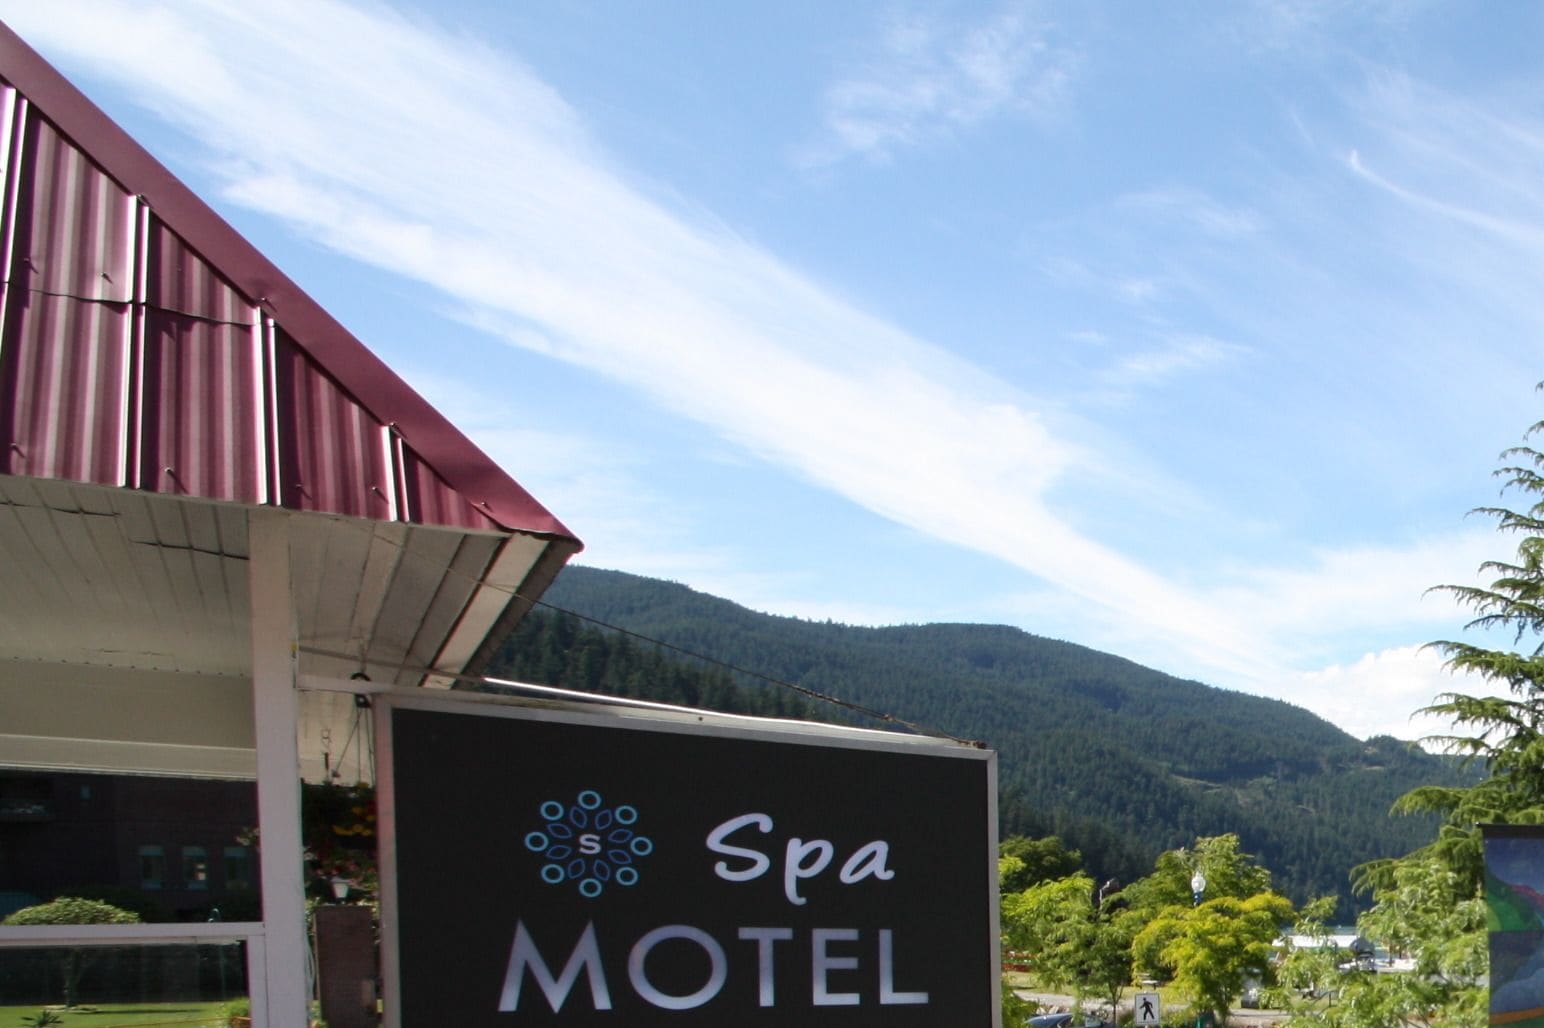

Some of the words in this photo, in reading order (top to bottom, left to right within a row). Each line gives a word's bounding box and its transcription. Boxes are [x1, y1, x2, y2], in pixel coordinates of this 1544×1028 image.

[578, 833, 602, 856] S
[706, 812, 896, 906] Spa
[498, 918, 930, 1014] MOTEL
